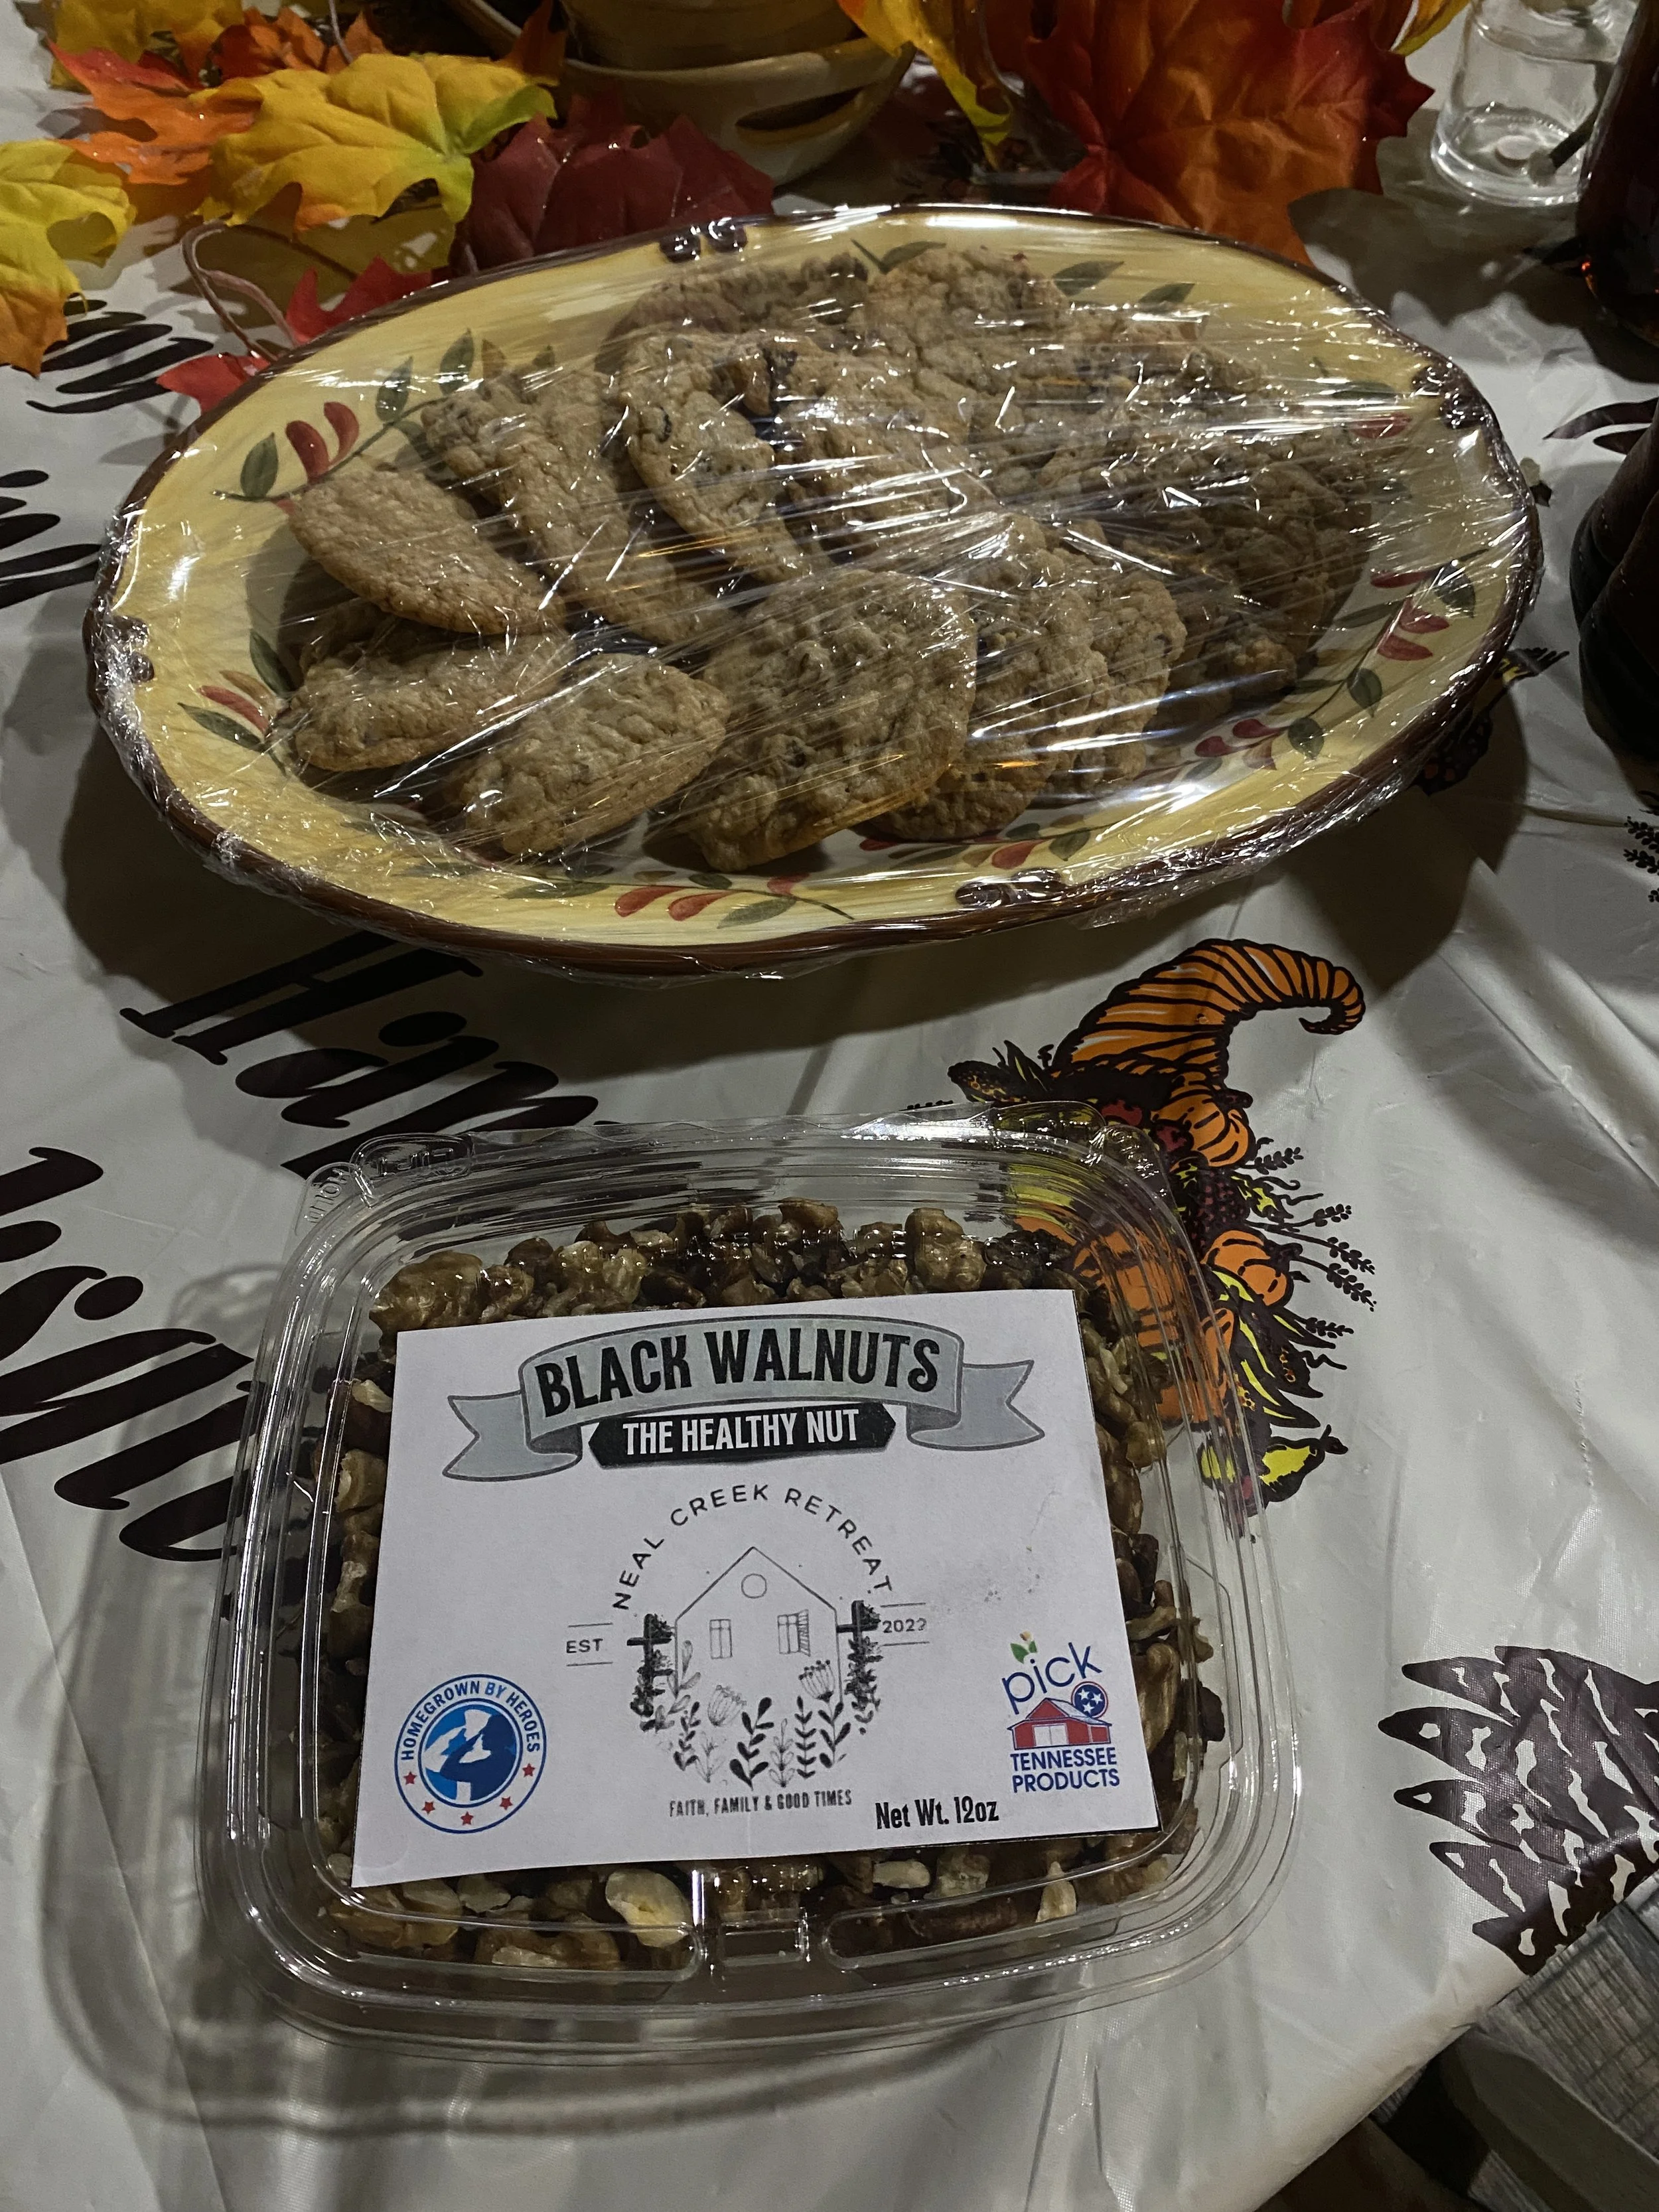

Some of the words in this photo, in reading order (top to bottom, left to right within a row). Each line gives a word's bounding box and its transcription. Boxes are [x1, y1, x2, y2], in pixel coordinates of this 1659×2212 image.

[535, 1335, 691, 1418] BLACK
[704, 1328, 940, 1392] WALNUTS
[622, 1422, 673, 1455] THE
[682, 1414, 798, 1453] HEALTHY
[807, 1409, 859, 1443] NUT
[613, 1536, 665, 1610] NEAL
[670, 1484, 768, 1526] CREEK
[784, 1488, 893, 1593] RETREAT
[566, 1638, 604, 1654] EST
[1002, 1642, 1103, 1715] pick
[401, 1680, 480, 1761] HOMEGROWN
[485, 1682, 506, 1698] BY
[506, 1692, 540, 1753] HEROES
[1010, 1747, 1117, 1771] TENNESSEE
[1012, 1769, 1119, 1793] PRODUCTS
[670, 1799, 709, 1817] FAITH,
[714, 1797, 759, 1814] FAMILY
[764, 1796, 772, 1810] &
[777, 1793, 810, 1810] GOOD
[814, 1789, 852, 1806] TIMES
[876, 1801, 910, 1829] Net
[915, 1799, 949, 1826] Wt.
[954, 1795, 999, 1824] 12oz
